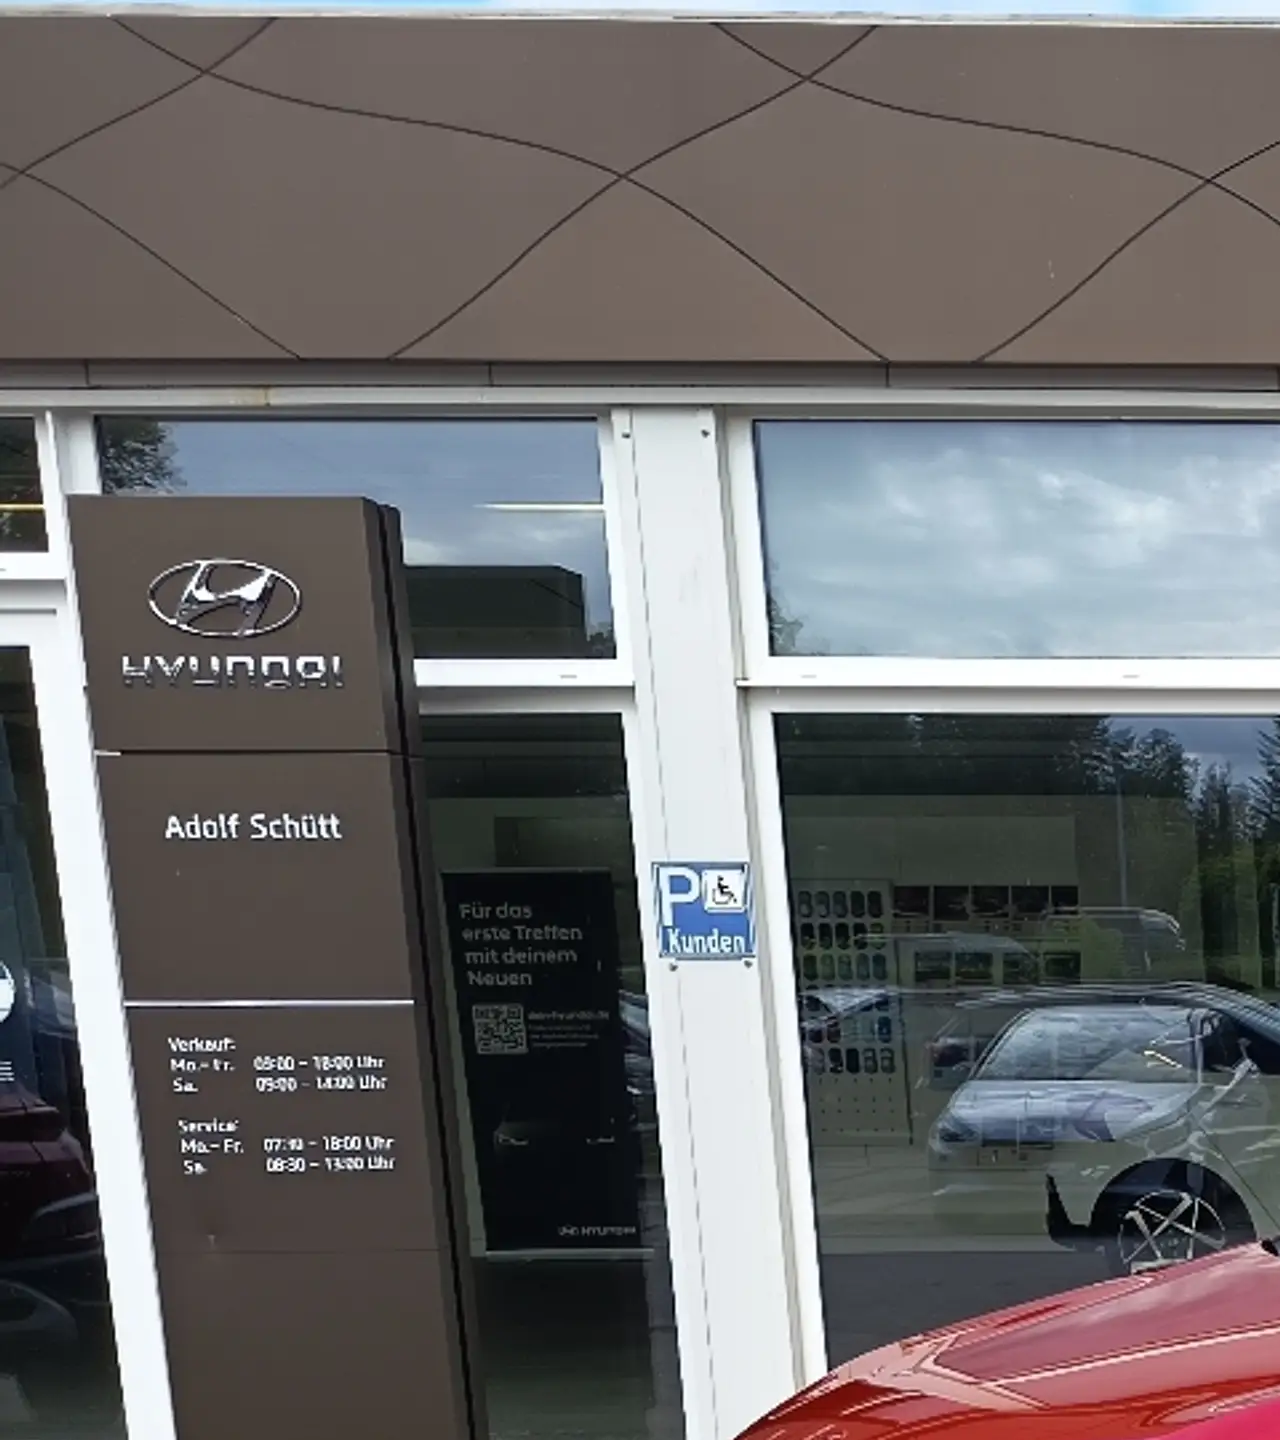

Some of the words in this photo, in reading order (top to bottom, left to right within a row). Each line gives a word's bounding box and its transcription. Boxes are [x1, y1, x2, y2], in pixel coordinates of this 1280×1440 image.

[121, 655, 344, 687] HYUNDAI
[165, 813, 240, 839] Adolf
[249, 813, 342, 839] Schütt
[658, 866, 700, 927] P
[459, 901, 491, 919] Für
[496, 901, 532, 919] das
[462, 926, 510, 941] erste
[513, 925, 583, 941] Treffen
[667, 927, 746, 953] Kunden
[465, 949, 499, 964] mit
[502, 948, 578, 964] deinem
[467, 970, 533, 986] Neuen
[253, 1056, 295, 1071] 08:00
[356, 1055, 385, 1070] Uhr
[256, 1077, 297, 1092] 09:00
[359, 1075, 387, 1090] Uhr
[365, 1136, 394, 1150] Uhr
[266, 1157, 305, 1173] 08:30
[367, 1156, 395, 1171] Uhr
